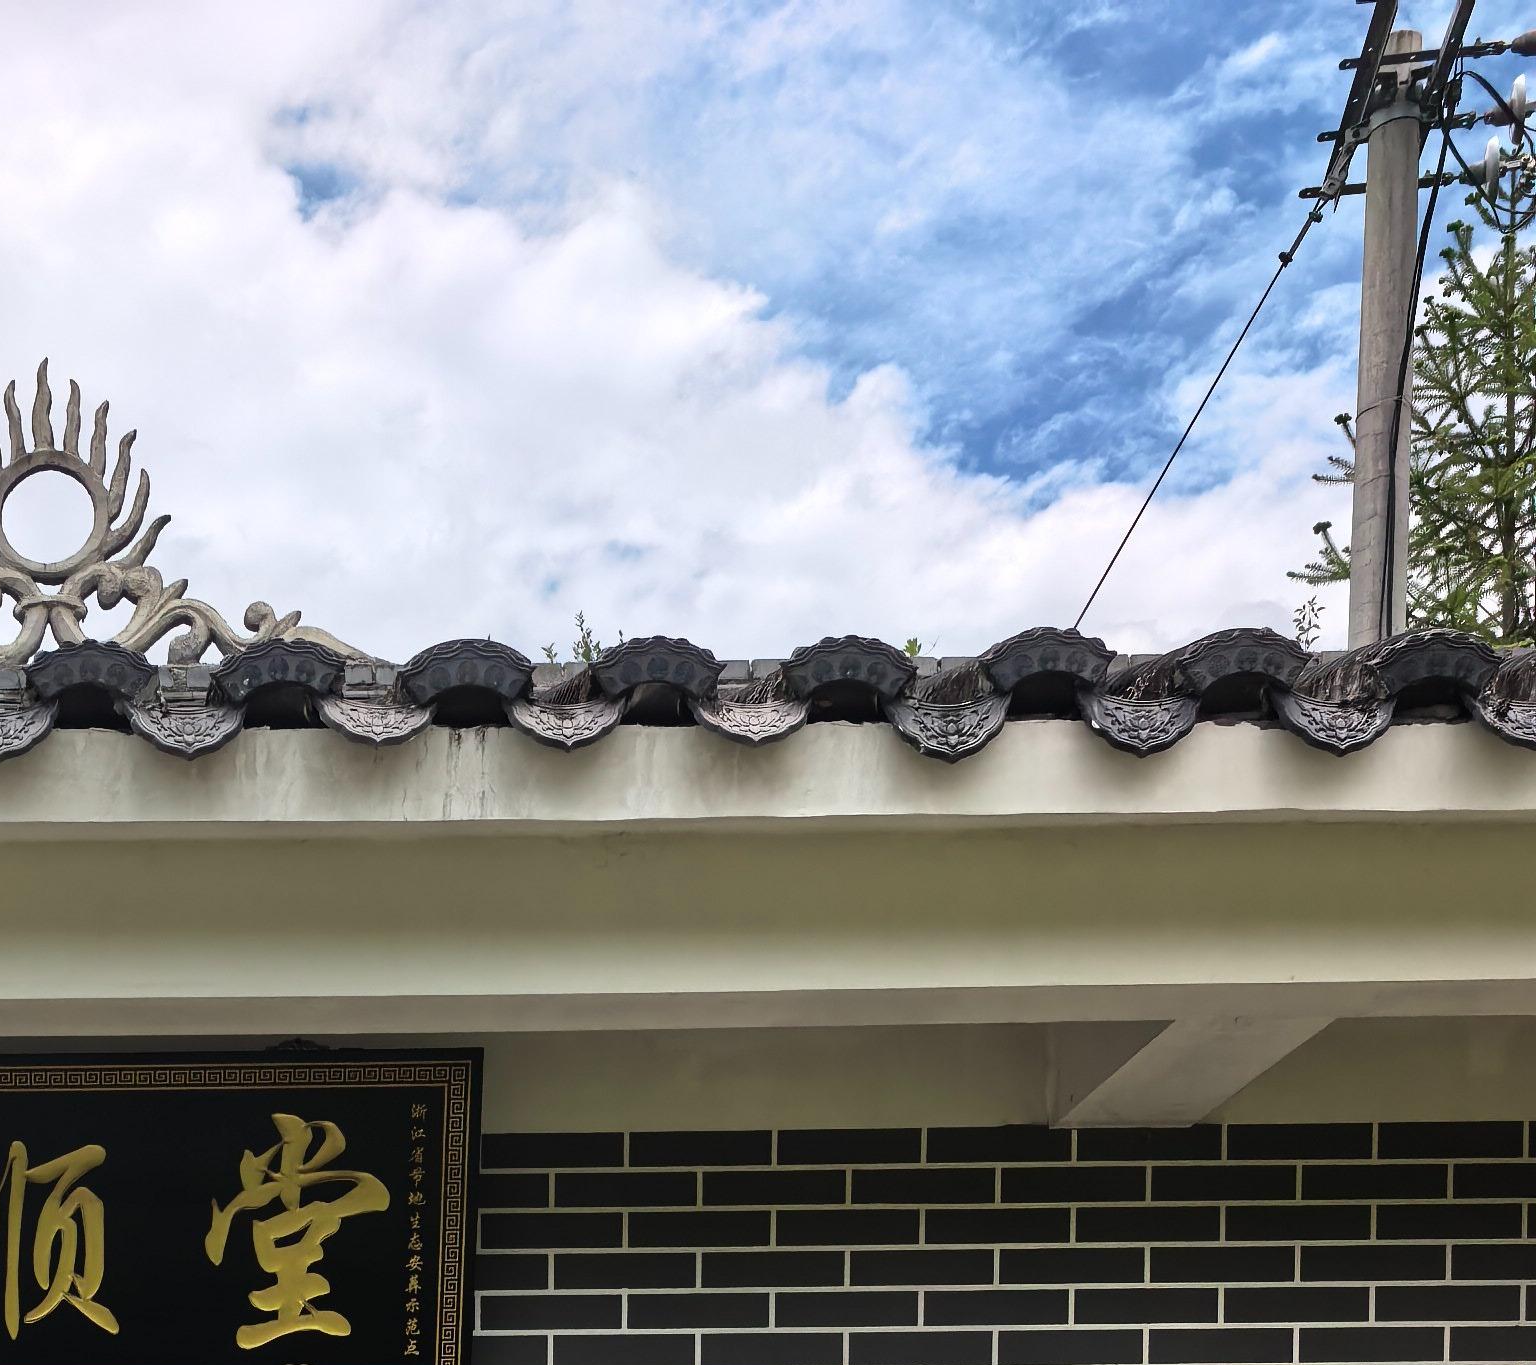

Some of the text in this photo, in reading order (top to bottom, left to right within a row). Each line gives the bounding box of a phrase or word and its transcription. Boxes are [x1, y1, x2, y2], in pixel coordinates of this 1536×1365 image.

[404, 1103, 428, 1356] 浙江省节地生态安葬示范点
